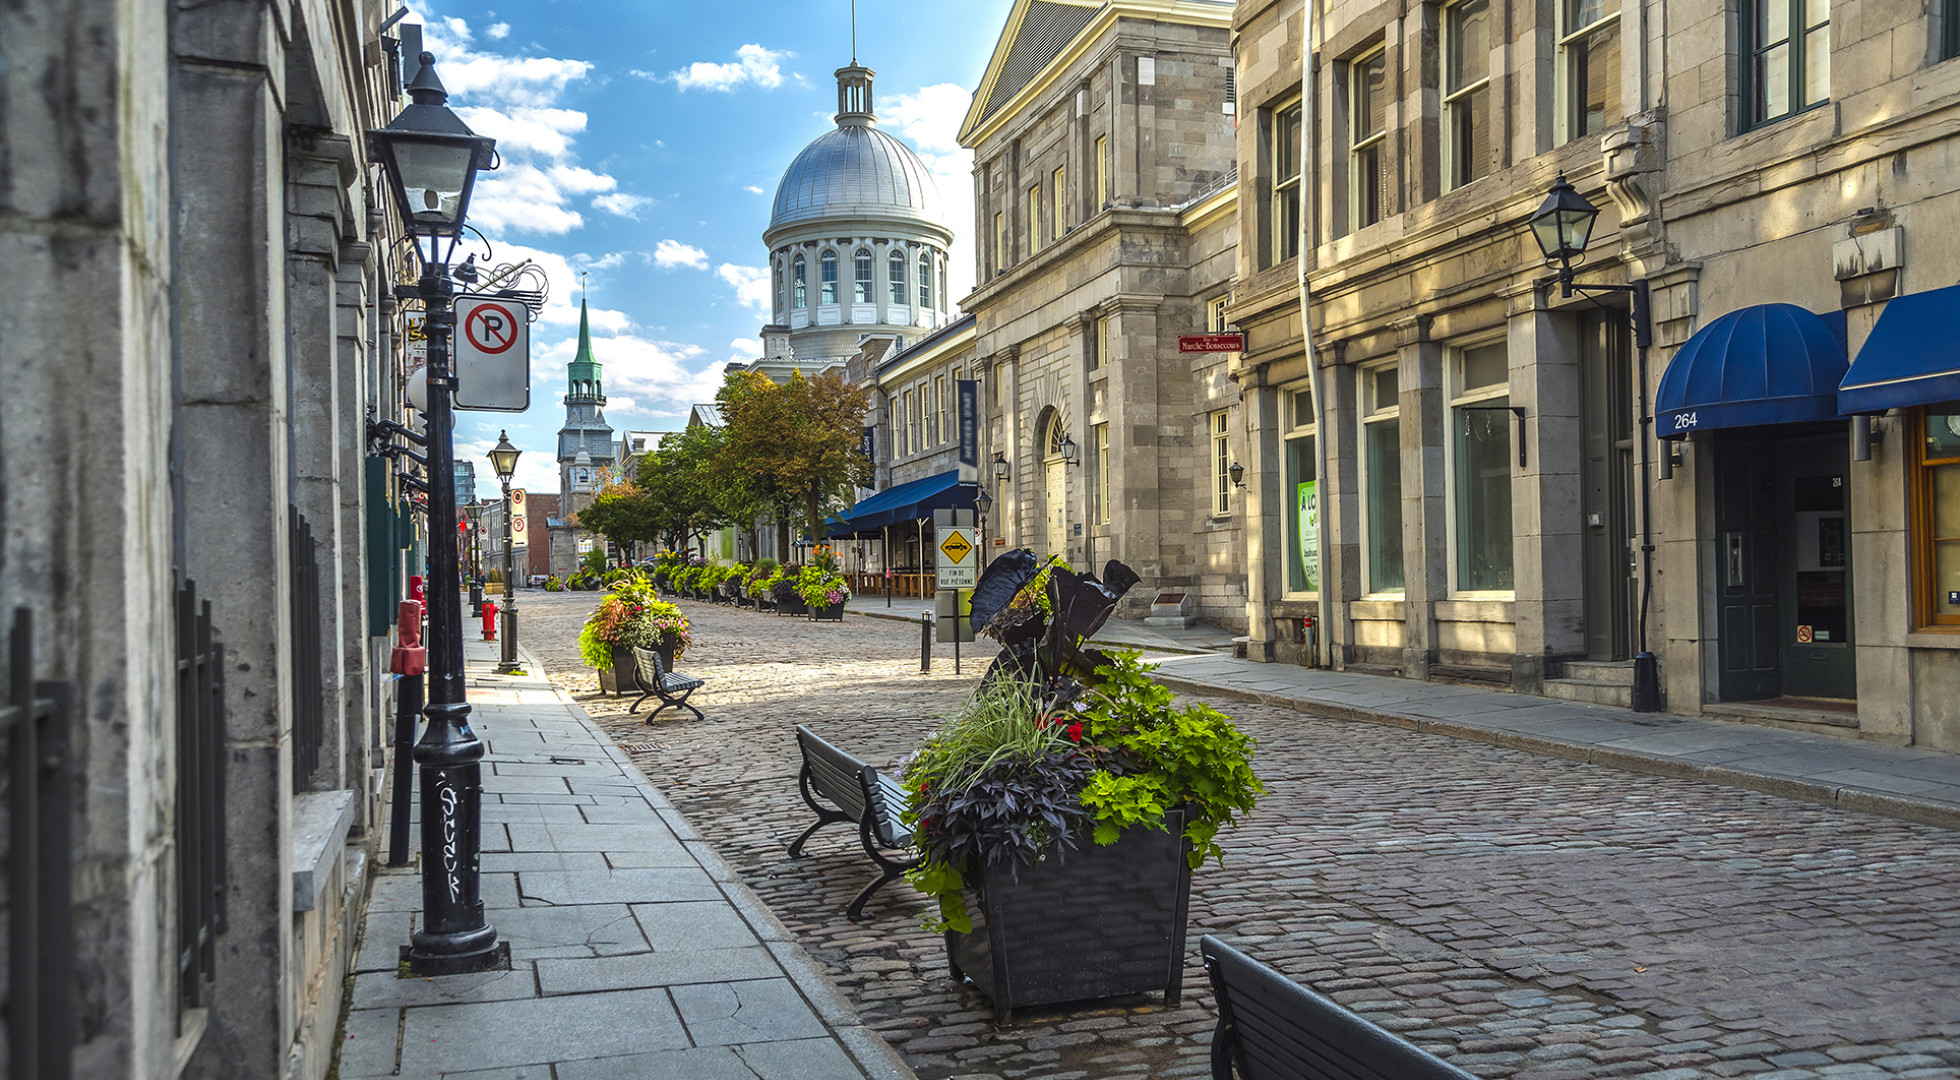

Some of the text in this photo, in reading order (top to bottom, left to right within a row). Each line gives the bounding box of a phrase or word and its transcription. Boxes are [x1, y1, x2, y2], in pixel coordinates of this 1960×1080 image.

[1182, 342, 1240, 350] Marché-Bonsecours
[1675, 412, 1697, 429] 264
[1833, 477, 1841, 487] 264
[1301, 490, 1306, 511] À
[951, 577, 974, 585] PIÉTONNE
